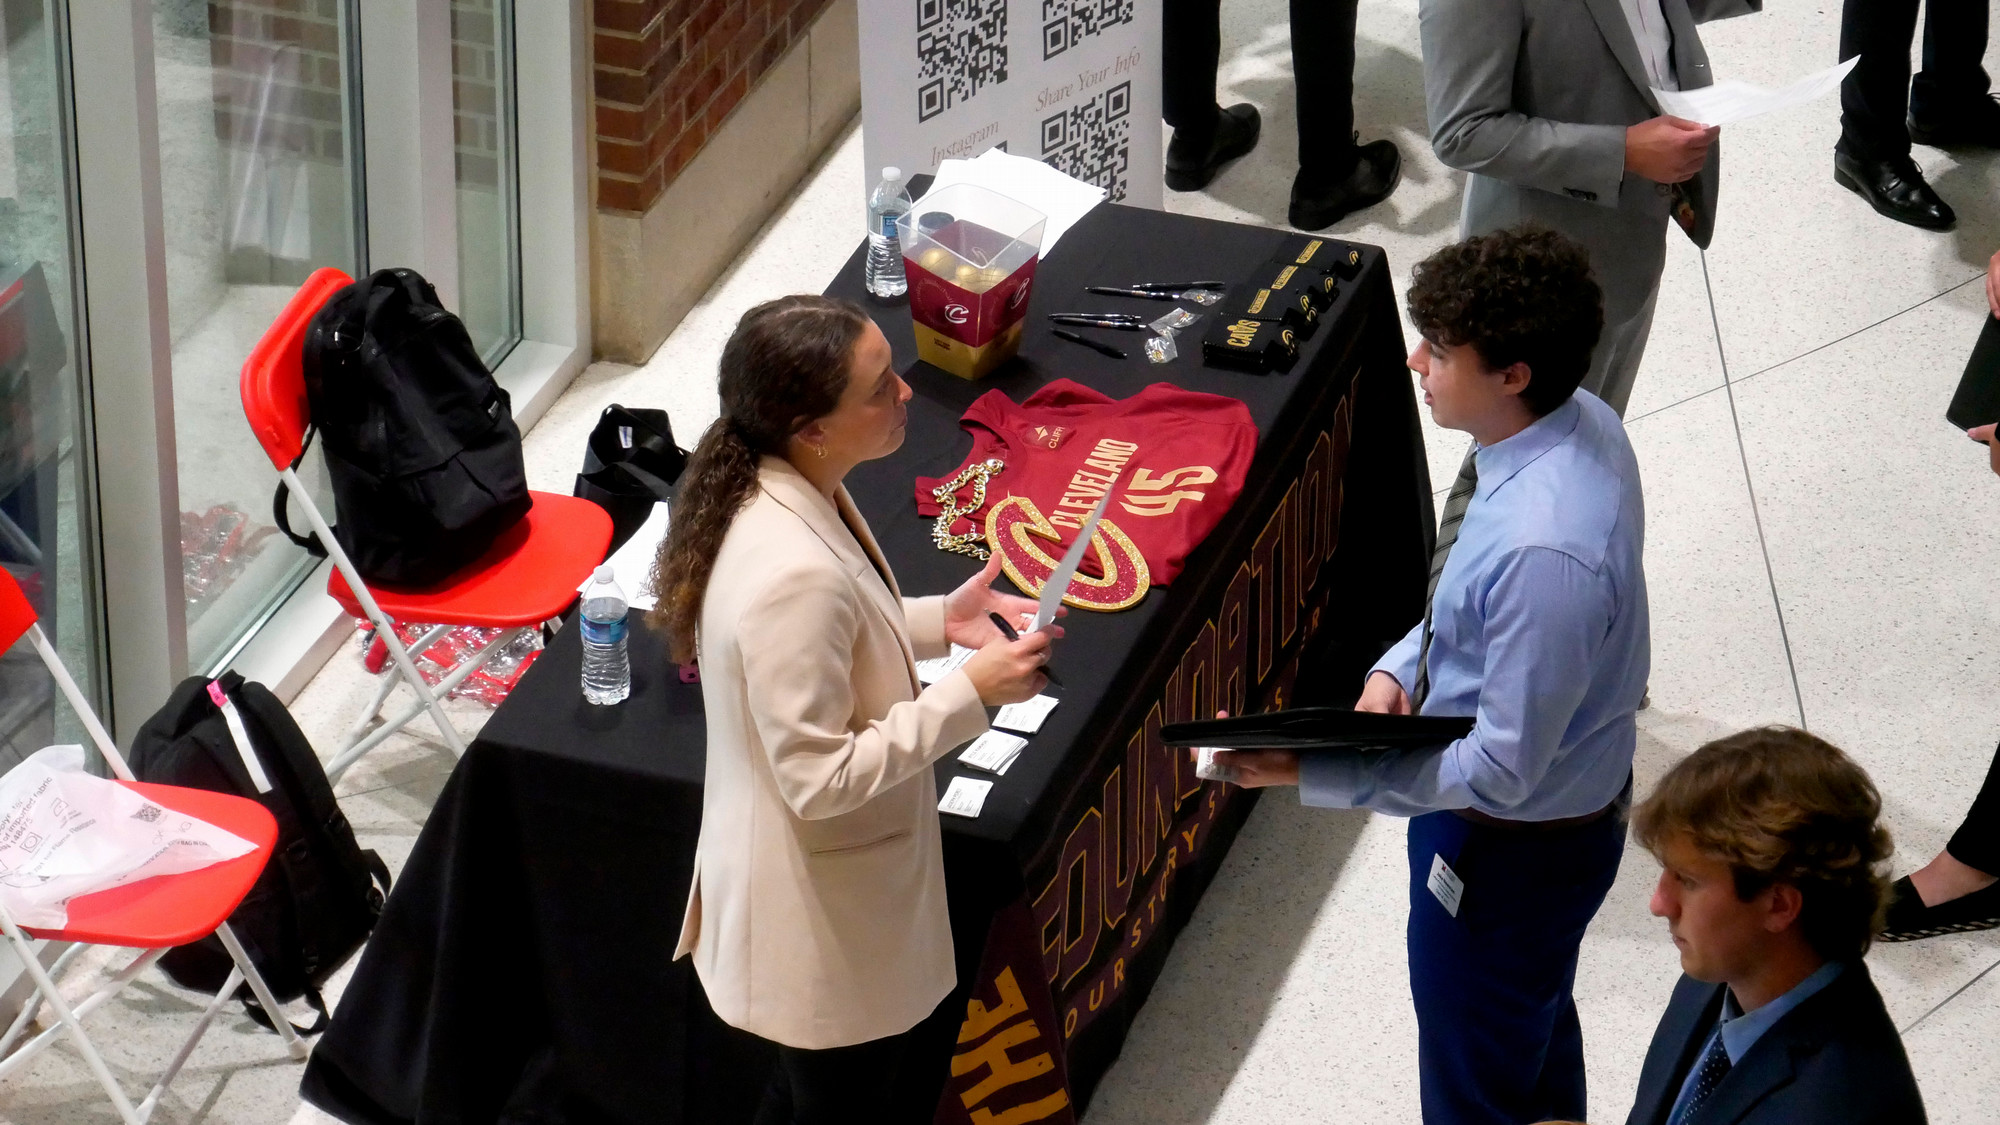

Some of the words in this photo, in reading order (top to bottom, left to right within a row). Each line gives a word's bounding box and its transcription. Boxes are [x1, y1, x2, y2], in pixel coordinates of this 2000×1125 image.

[1035, 83, 1073, 112] Share
[1078, 67, 1110, 92] Your
[1114, 46, 1141, 75] Info
[931, 121, 1000, 166] Instagram
[1227, 319, 1261, 347] CAVS
[1048, 438, 1139, 530] CLEVELAND
[1119, 465, 1219, 517] 45
[9, 798, 36, 832] imported
[34, 776, 52, 798] fabric
[1065, 957, 1125, 1039] OUR
[1131, 824, 1200, 949] STORY
